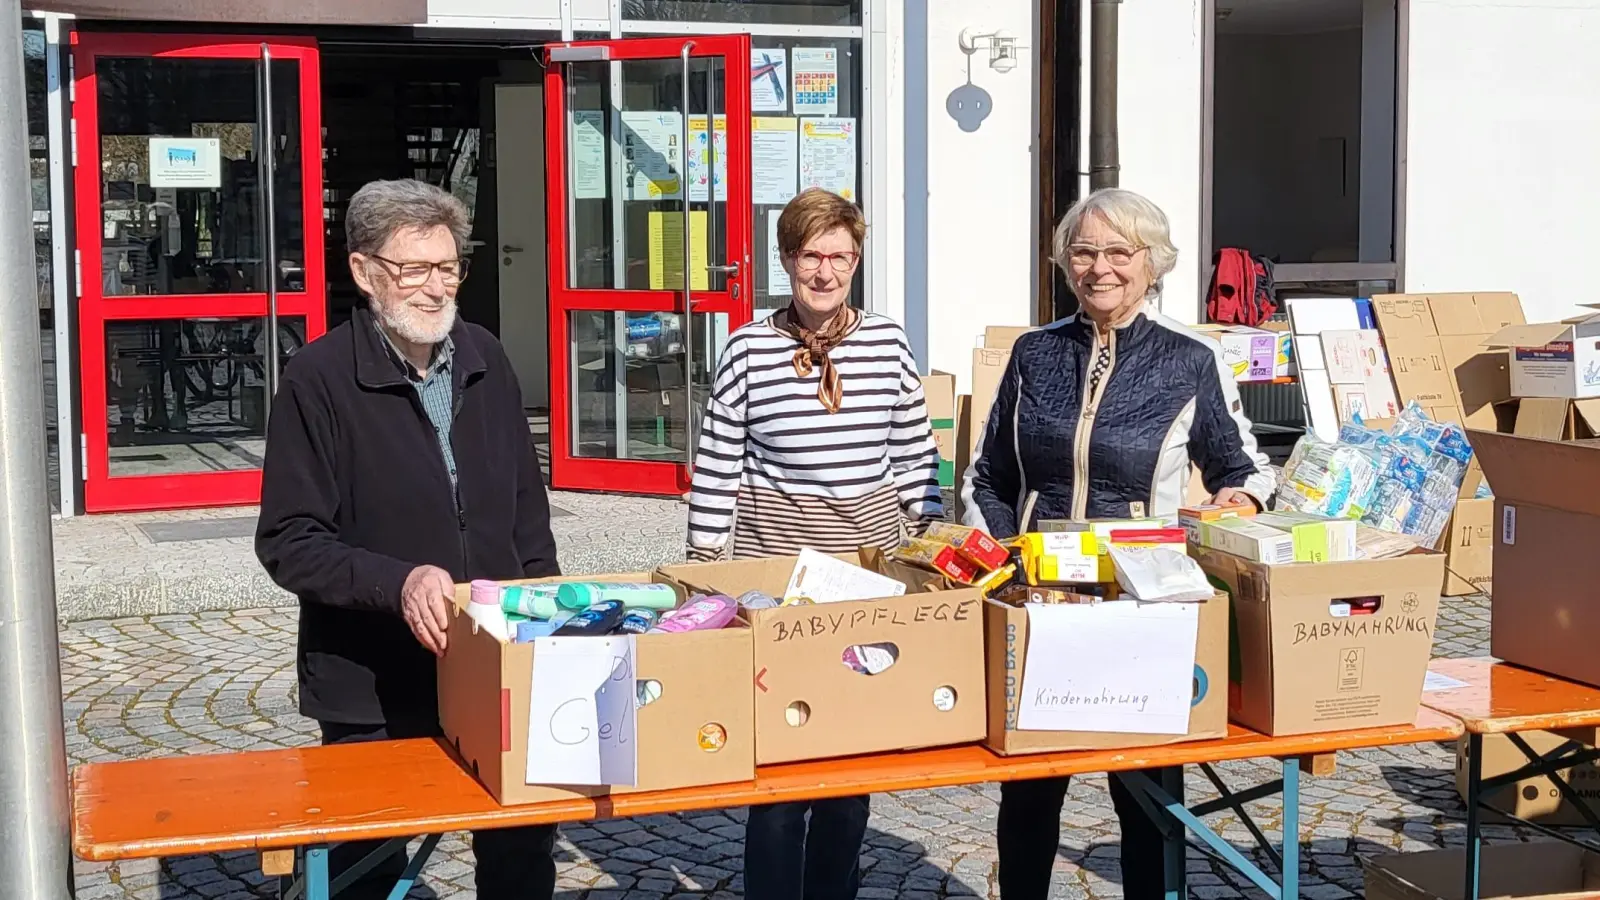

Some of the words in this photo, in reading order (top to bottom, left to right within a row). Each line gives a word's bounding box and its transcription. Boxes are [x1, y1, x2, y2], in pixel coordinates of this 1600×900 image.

[773, 599, 979, 642] BABYPFLEGE
[1292, 614, 1430, 645] BABYNAHRUNG
[1034, 687, 1149, 712] Kindernahrung
[549, 697, 629, 745] Gel
